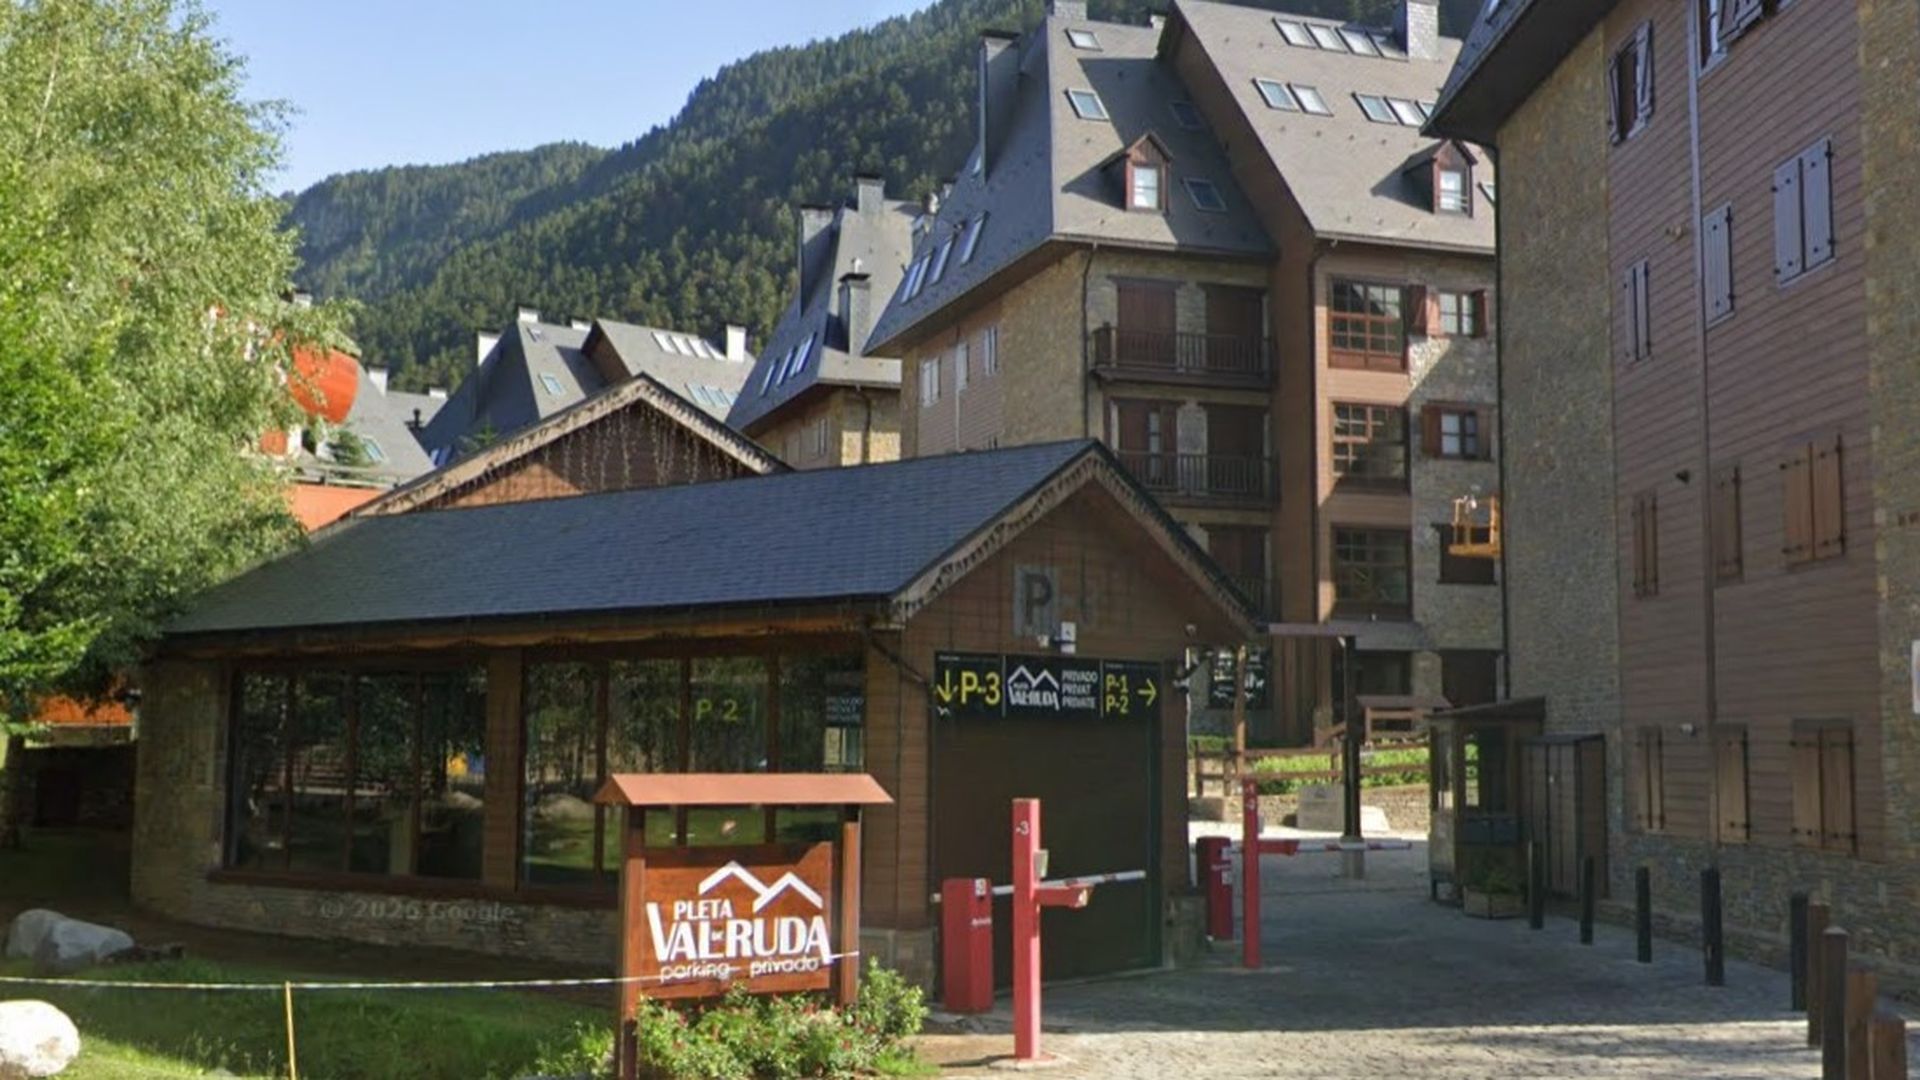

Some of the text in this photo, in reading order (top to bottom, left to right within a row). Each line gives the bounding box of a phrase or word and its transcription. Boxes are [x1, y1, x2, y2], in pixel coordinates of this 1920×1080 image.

[1062, 670, 1098, 683] PRIVADO
[1106, 673, 1129, 693] P-1
[961, 671, 1000, 705] P-3
[1062, 683, 1091, 696] PRIVAT
[1106, 694, 1129, 713] P-2
[674, 898, 734, 921] PLETA
[660, 955, 821, 985] parking privado
